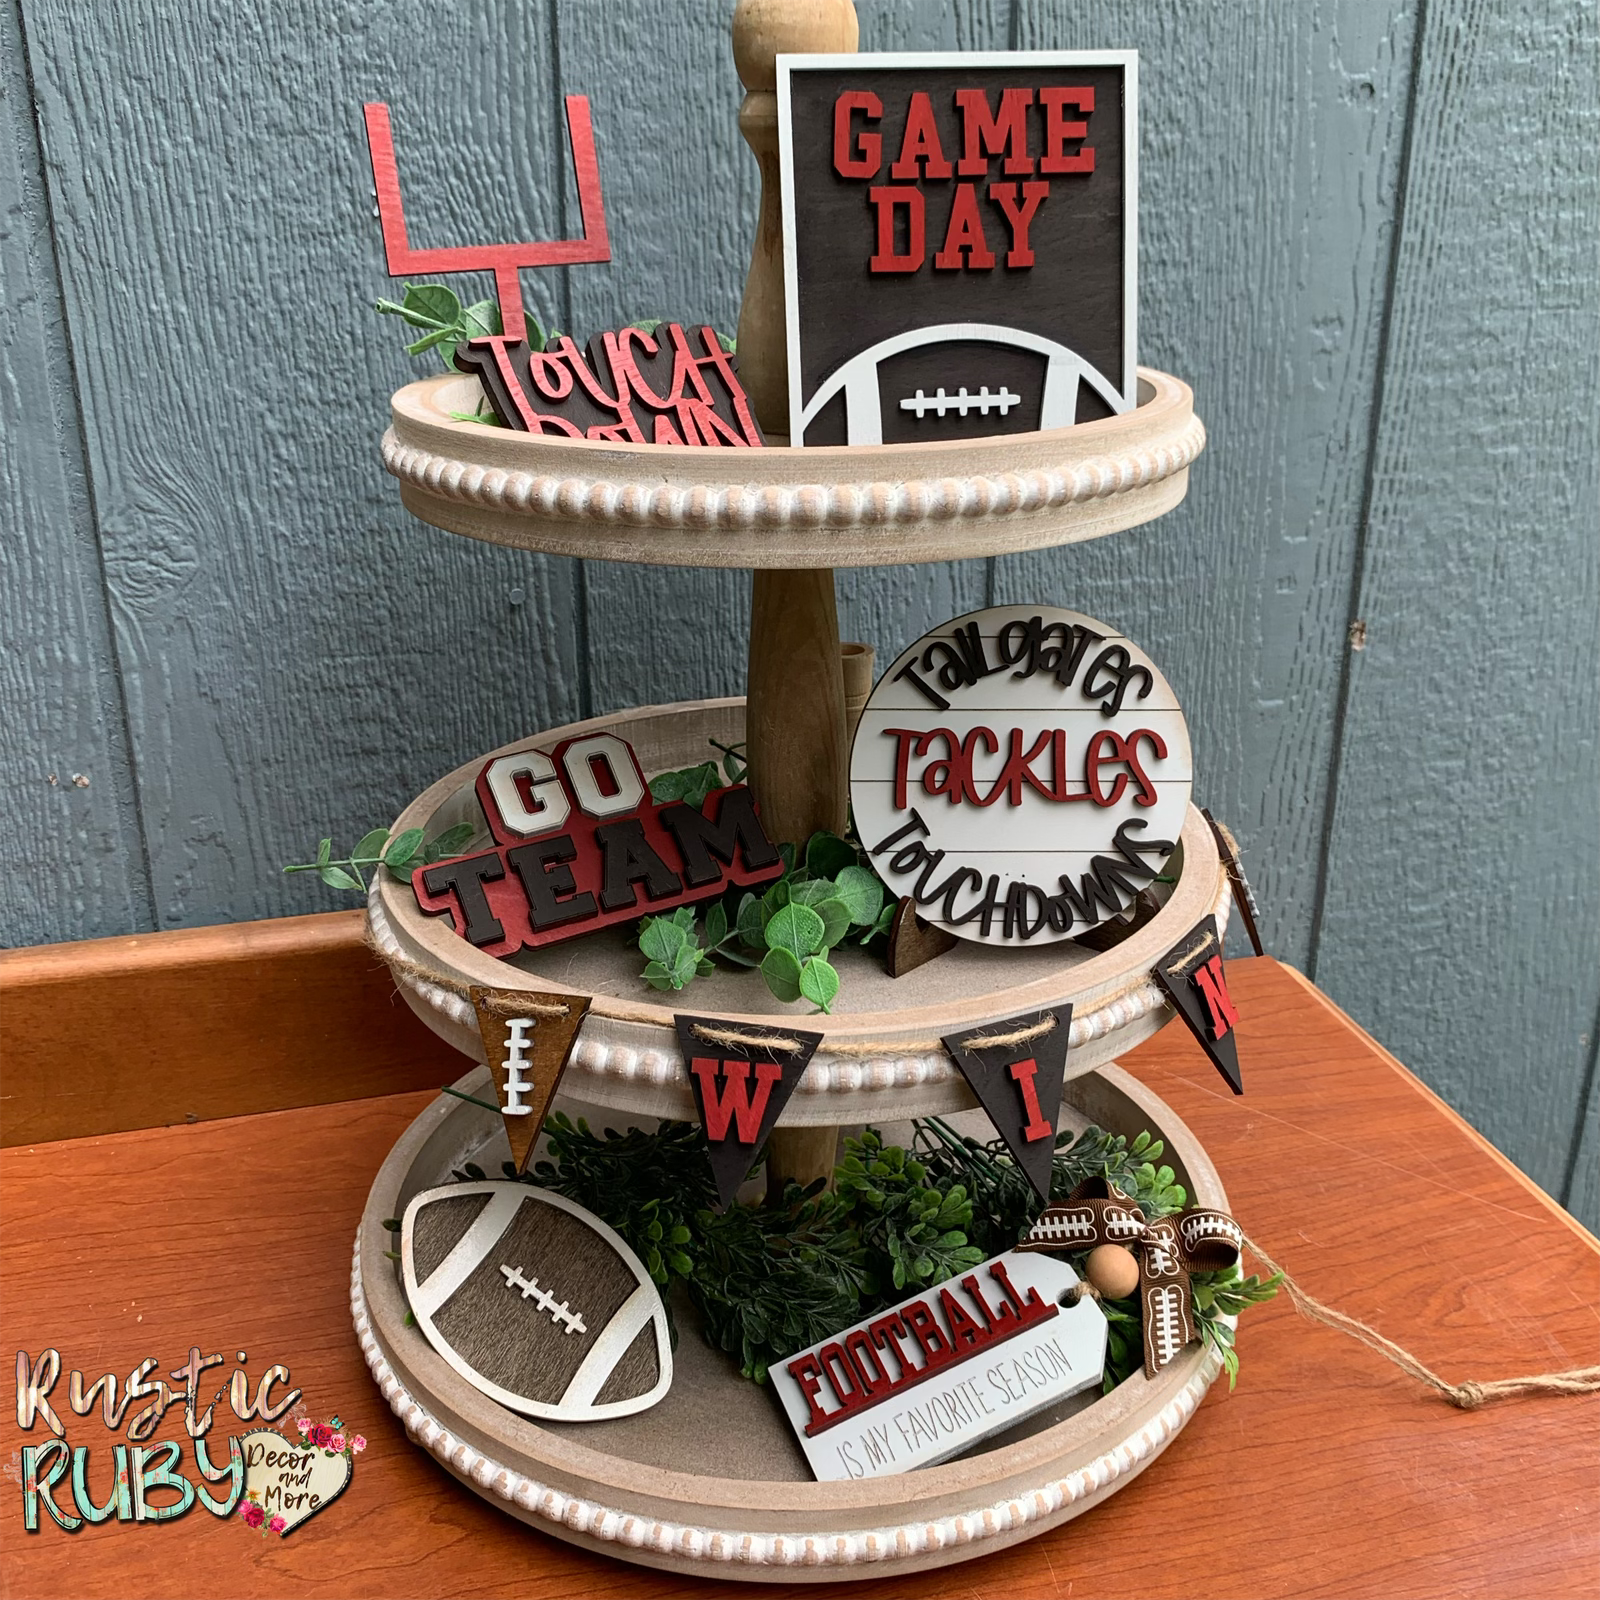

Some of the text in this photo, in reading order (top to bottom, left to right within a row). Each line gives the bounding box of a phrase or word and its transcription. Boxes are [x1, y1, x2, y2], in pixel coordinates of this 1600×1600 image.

[834, 86, 1096, 180] GAME
[870, 181, 1049, 273] DAY
[485, 733, 646, 840] GO
[421, 786, 782, 946] TEAM
[788, 1259, 1059, 1438] FOOTBALL
[836, 1338, 1074, 1480] IS MY FAVORITE SEASON
